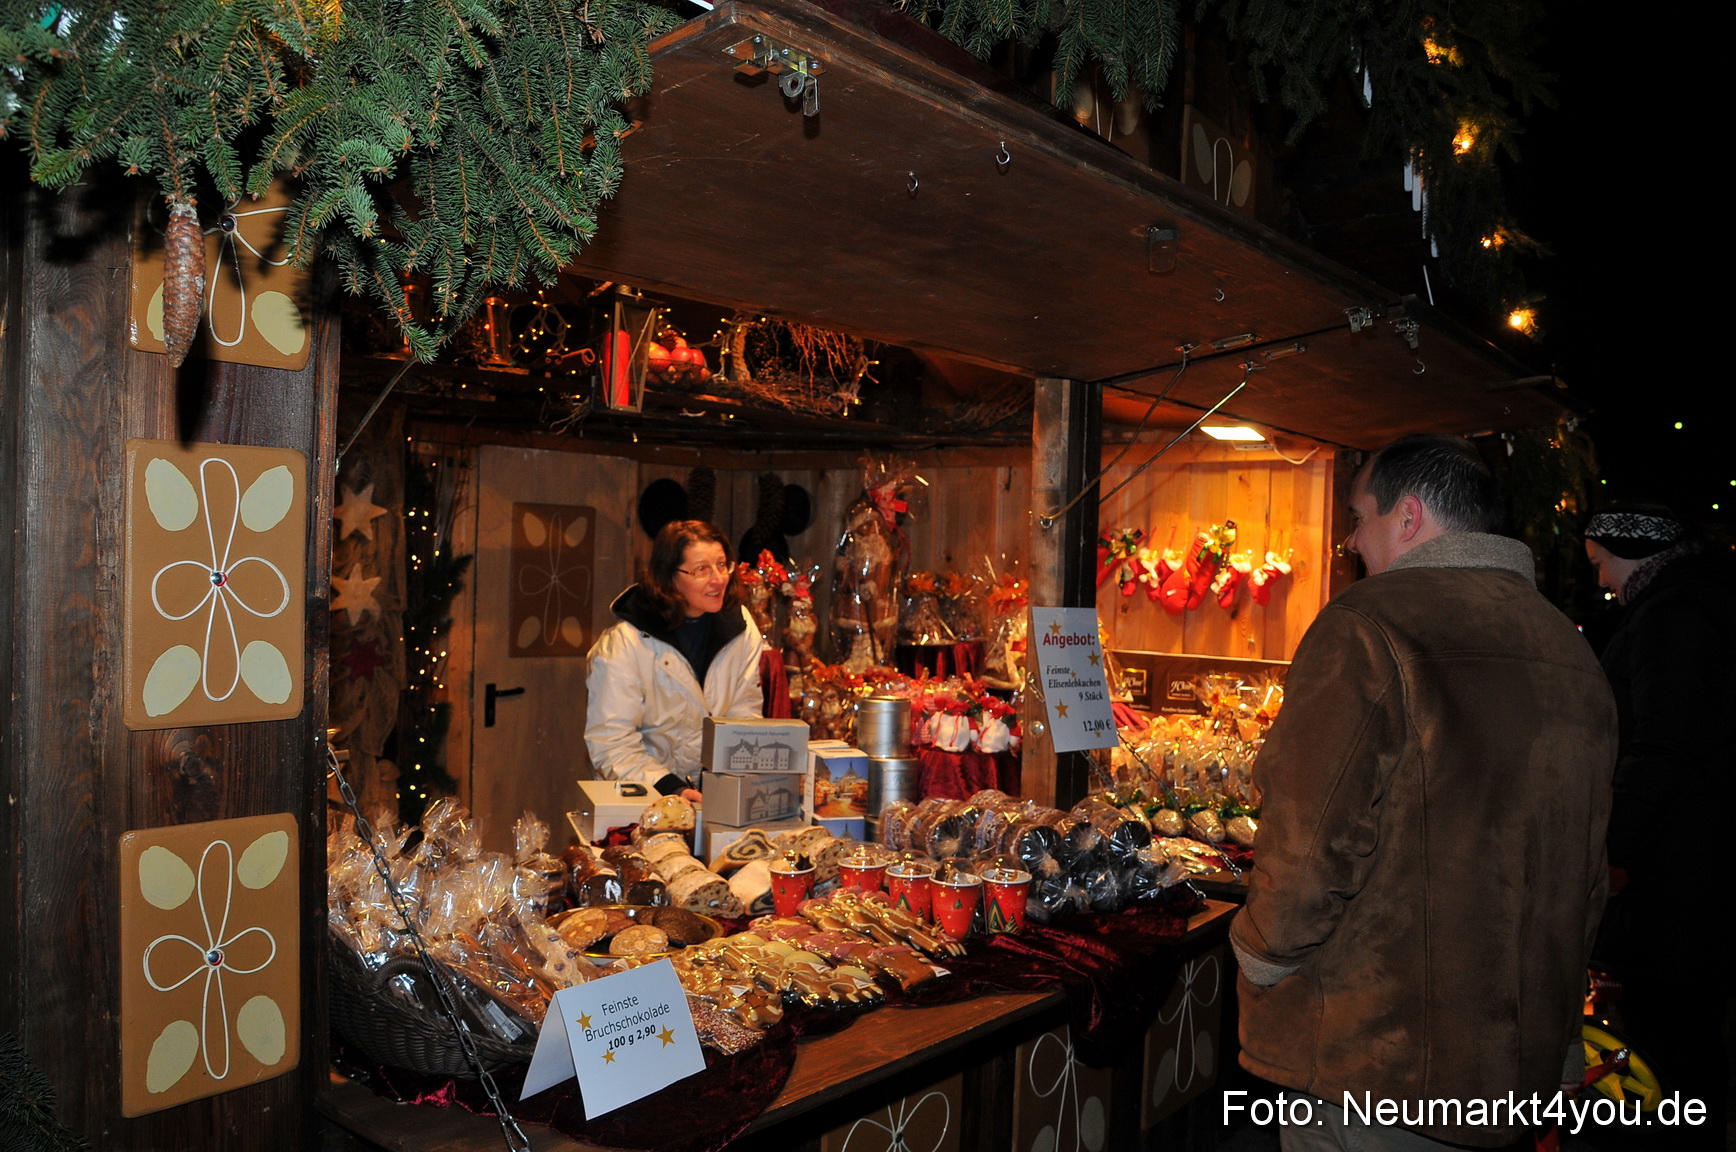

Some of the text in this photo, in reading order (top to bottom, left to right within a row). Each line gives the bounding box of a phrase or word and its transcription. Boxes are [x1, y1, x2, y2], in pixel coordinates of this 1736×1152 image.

[1042, 632, 1095, 648] Angebot:
[1046, 665, 1070, 675] Feinste
[1048, 678, 1101, 688] Elisenlebkuchen
[1078, 691, 1103, 701] 9 Stück
[1106, 719, 1111, 730] €
[601, 996, 640, 1016] Feinste
[584, 1003, 670, 1042] Bruchschokolade
[608, 1024, 656, 1050] 100 g 2,90
